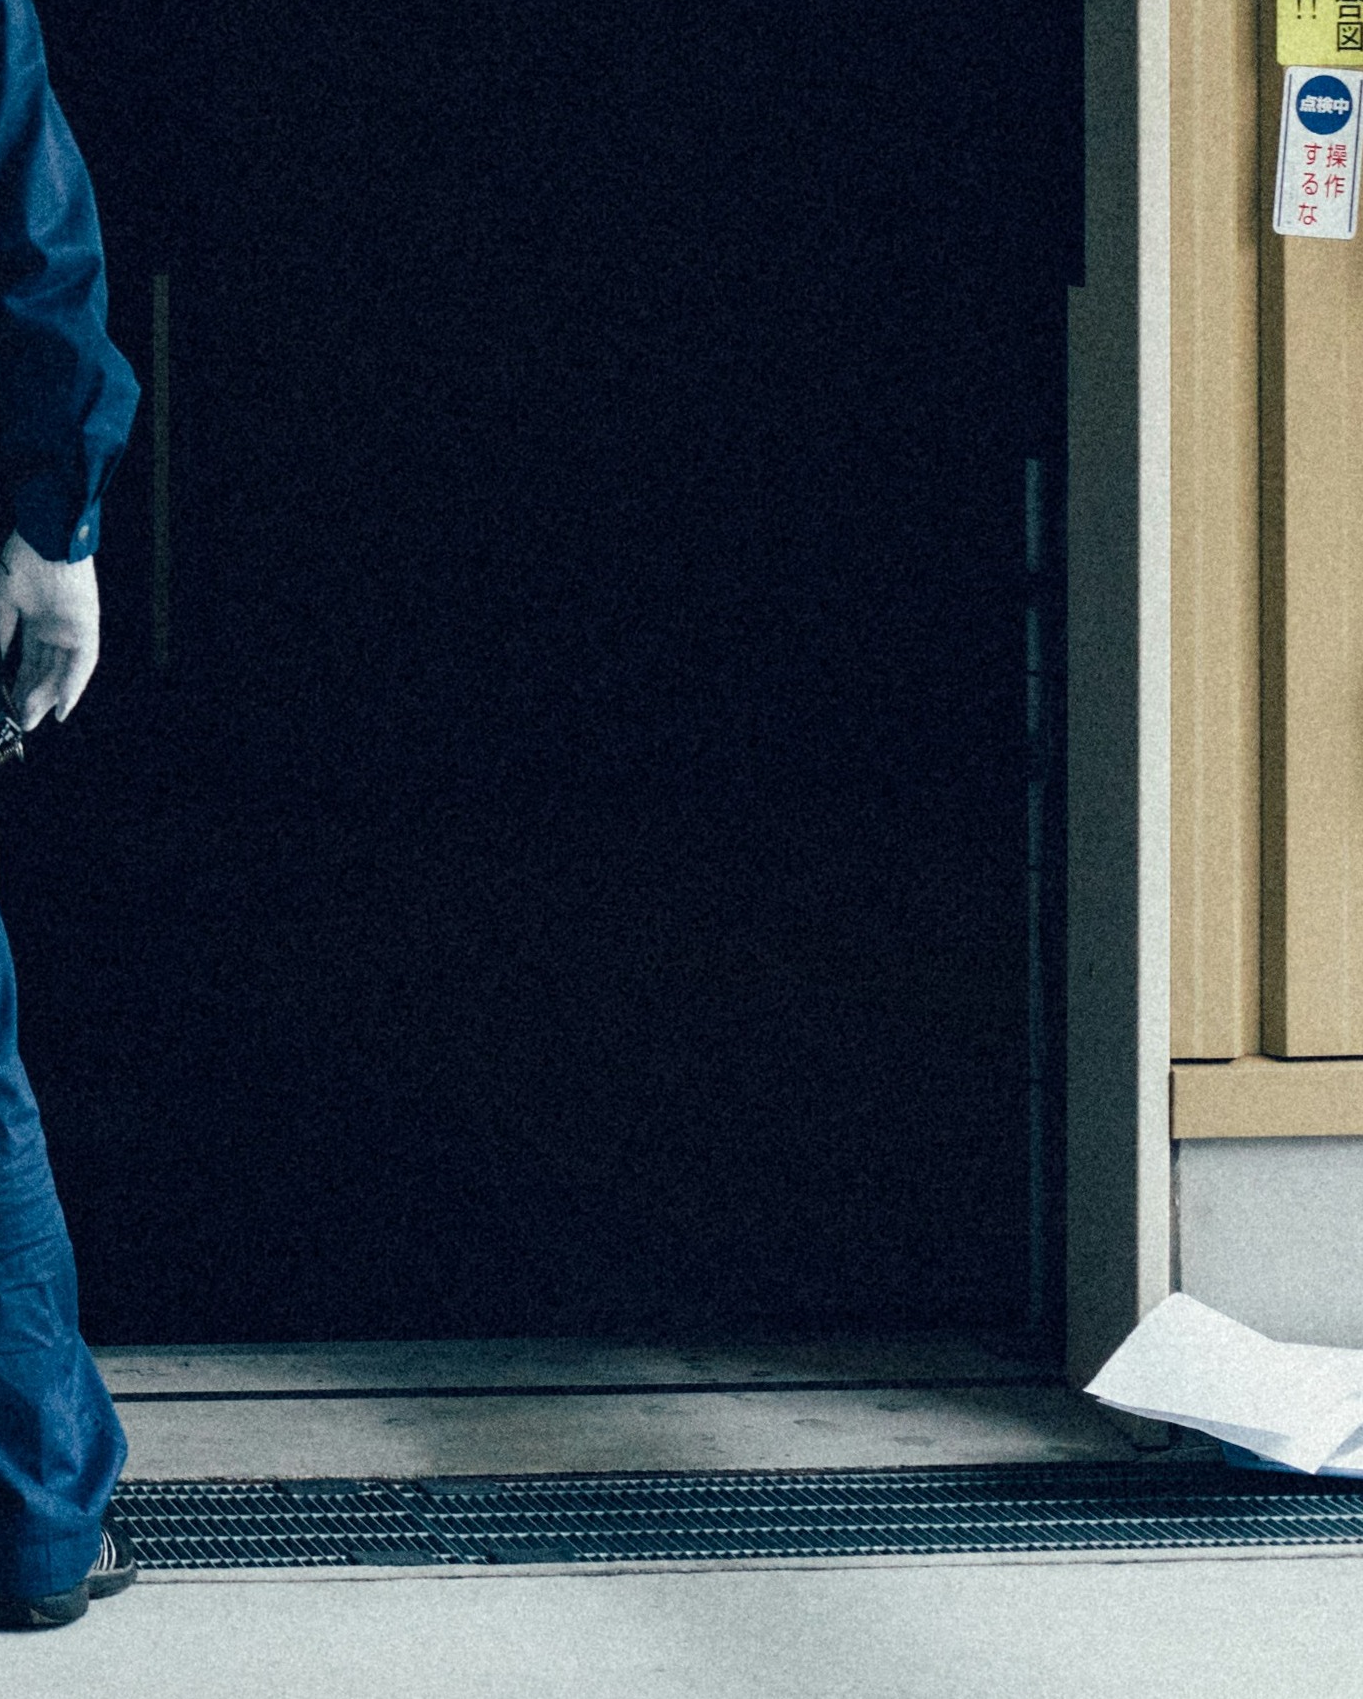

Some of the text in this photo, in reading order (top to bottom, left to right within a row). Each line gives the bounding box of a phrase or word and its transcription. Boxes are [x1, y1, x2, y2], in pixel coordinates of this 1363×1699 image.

[1300, 95, 1350, 115] 点検中
[1298, 144, 1323, 225] するな
[1324, 145, 1347, 198] 操作
